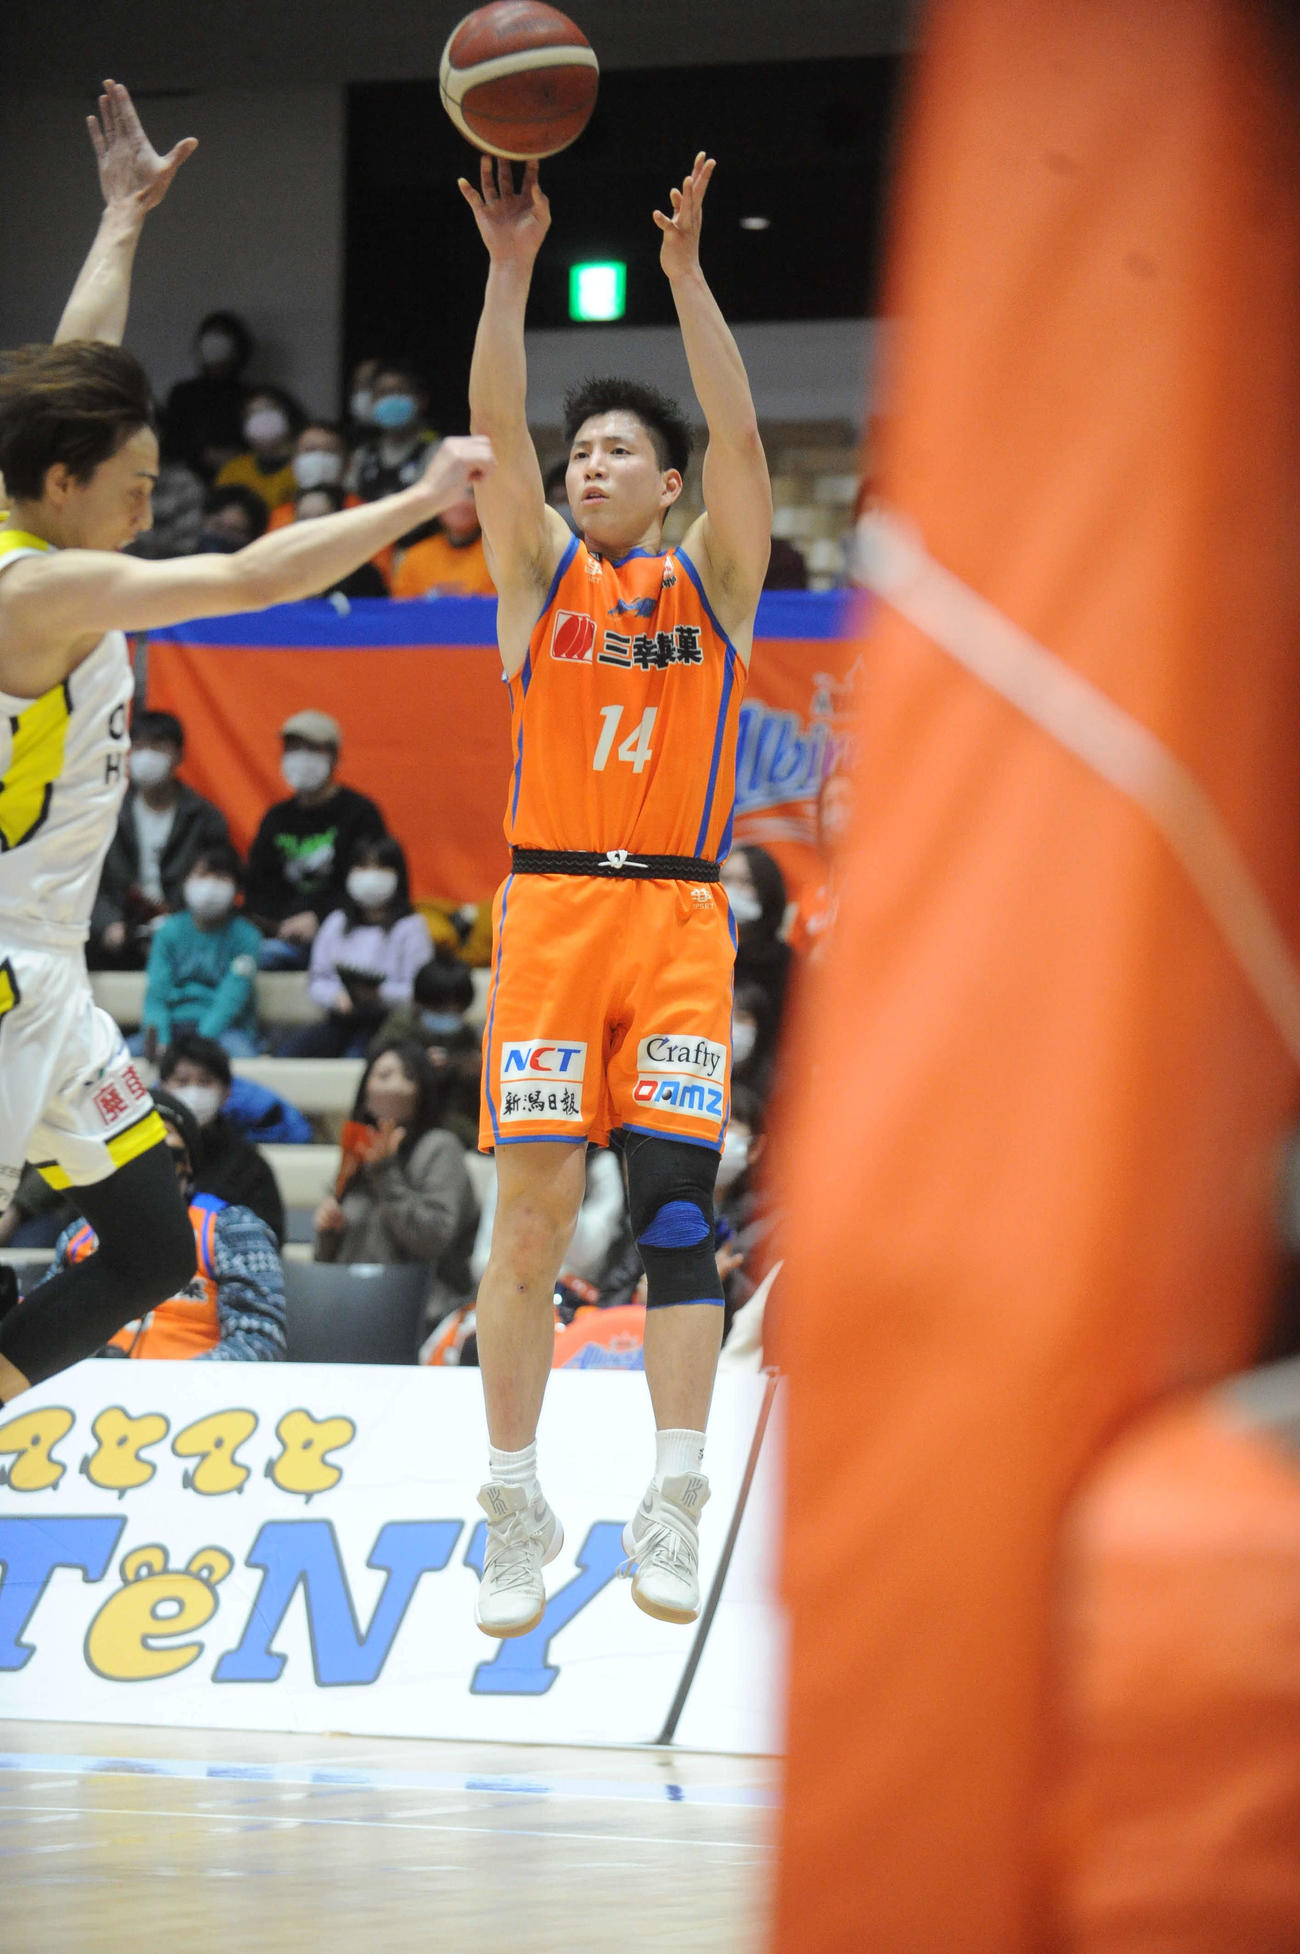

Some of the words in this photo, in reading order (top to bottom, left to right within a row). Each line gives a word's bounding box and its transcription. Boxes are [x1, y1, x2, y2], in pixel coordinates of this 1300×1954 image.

[592, 704, 658, 774] 14
[504, 1047, 581, 1073] NCT
[646, 1037, 721, 1077] Crafty
[503, 1088, 580, 1116] 新潟日報
